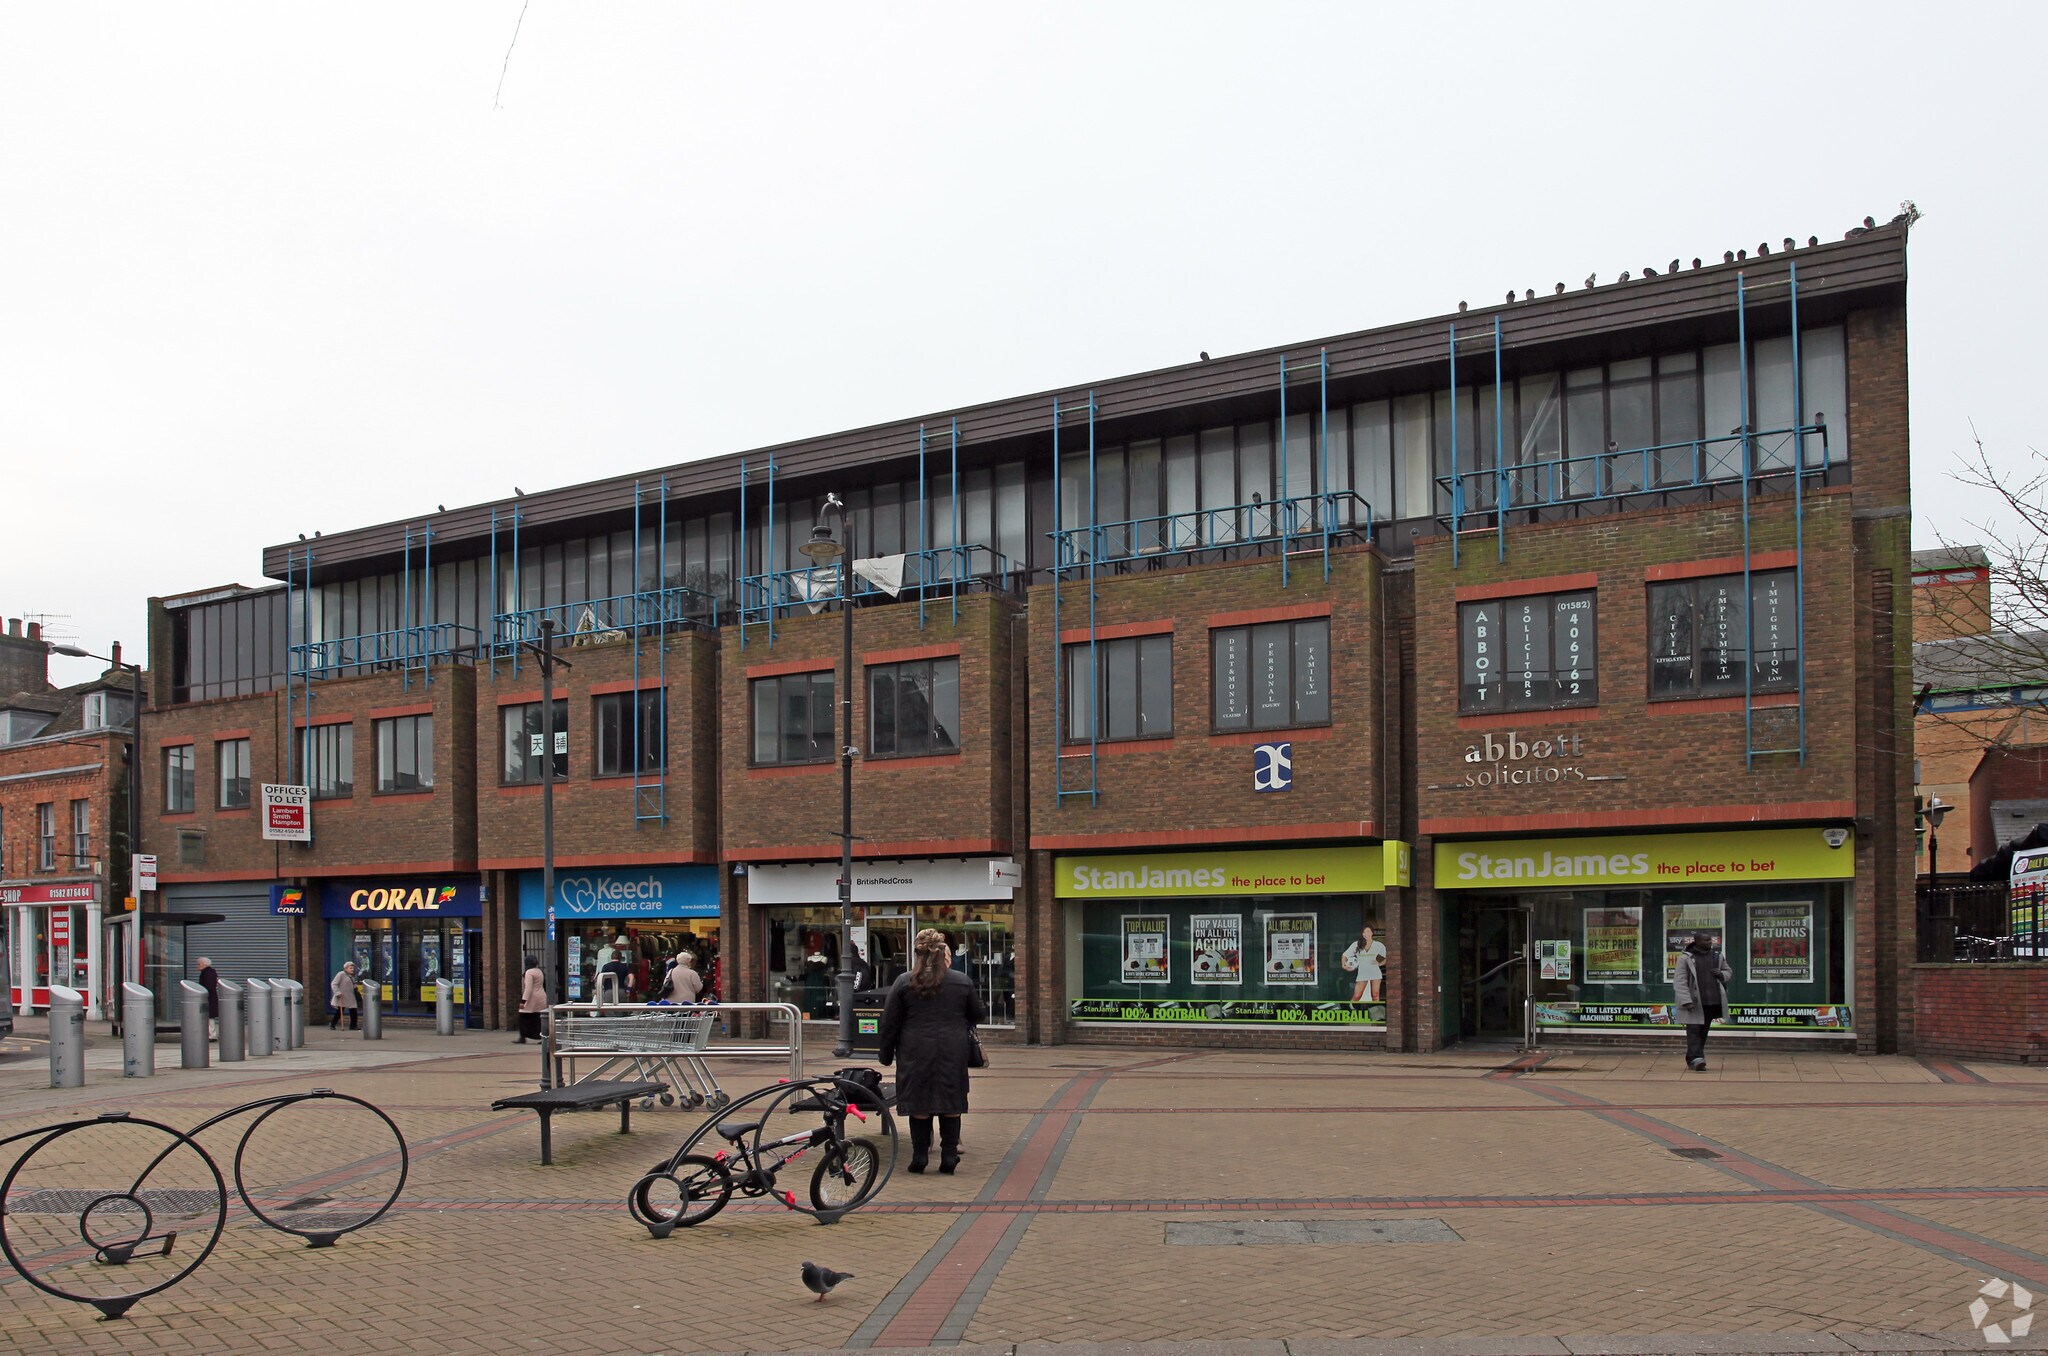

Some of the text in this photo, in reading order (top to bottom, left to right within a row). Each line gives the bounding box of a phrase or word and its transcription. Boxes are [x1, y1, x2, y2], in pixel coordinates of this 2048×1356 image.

[1557, 600, 1590, 612] (01582)
[1718, 588, 1728, 673] EMPLOYMENT
[1768, 581, 1779, 675] IMMIGRATION
[1476, 610, 1489, 700] ABBOTT
[1522, 606, 1532, 697] SOLICITORS
[1570, 613, 1580, 694] 406762
[1464, 731, 1585, 763] abbott
[1465, 762, 1585, 788] solicitors
[265, 786, 307, 796] OFFICES
[1656, 862, 1680, 874] the
[1685, 861, 1726, 876] place
[1730, 861, 1746, 872] to
[1750, 860, 1775, 872] bet
[597, 875, 662, 899] Keech
[1232, 876, 1250, 887] the
[1254, 875, 1286, 888] place
[1289, 876, 1301, 886] to
[1306, 874, 1325, 885] bet
[49, 889, 65, 898] 01582
[66, 889, 73, 897] 87
[74, 888, 80, 897] 64
[82, 888, 89, 896] 64
[350, 887, 440, 911] CORAL
[598, 900, 662, 912] hospice care
[1126, 921, 1165, 932] TOP VALUE
[1196, 919, 1237, 928] TOP VALUE
[1268, 920, 1313, 931] ALL THE ACTION
[1195, 928, 1237, 937] ON ALL THE
[1753, 928, 1806, 938] RETURNS
[1195, 938, 1237, 950] ACTION
[1588, 939, 1637, 950] BEST PRICE
[1121, 1007, 1150, 1019] 100%
[1152, 1008, 1206, 1020] FOOTBALL
[1276, 1009, 1307, 1021] 100%
[1311, 1009, 1370, 1022] FOOTBALL
